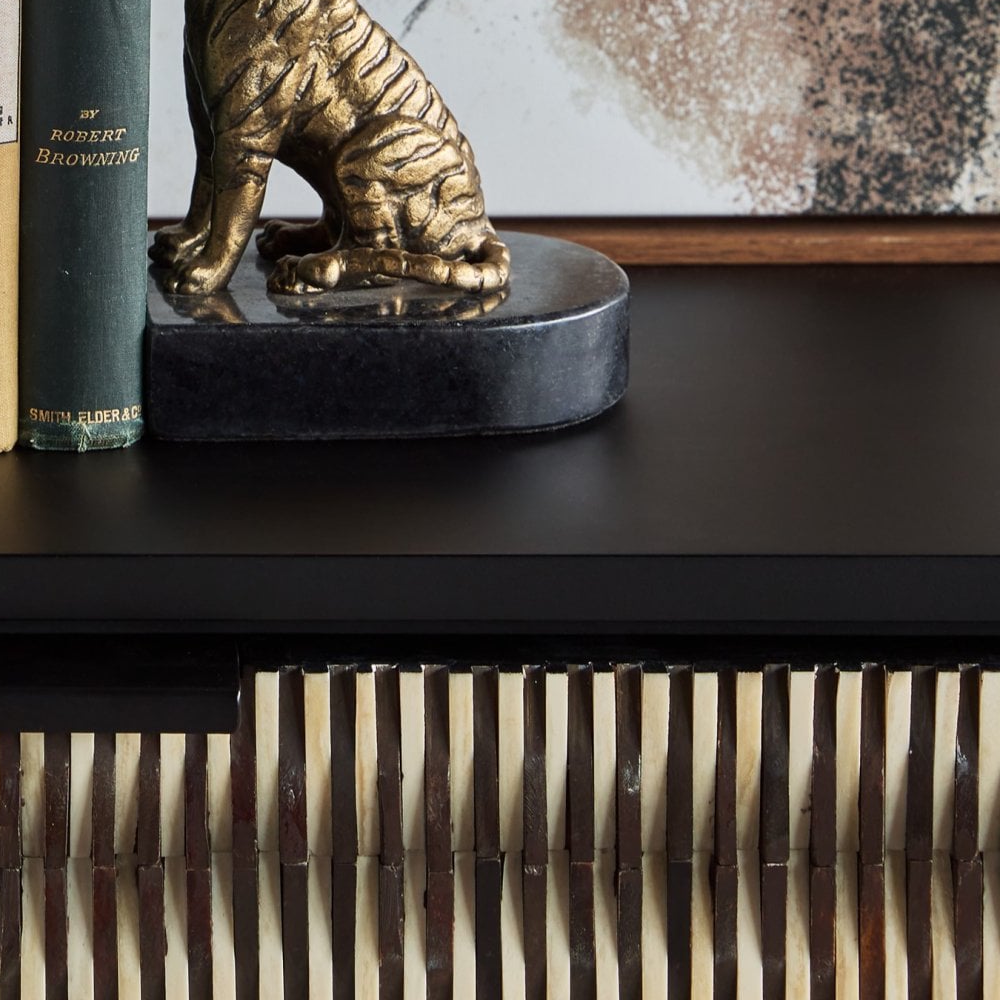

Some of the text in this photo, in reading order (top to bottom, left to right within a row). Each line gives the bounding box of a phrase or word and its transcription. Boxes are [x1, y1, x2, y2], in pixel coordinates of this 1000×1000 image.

[80, 109, 100, 119] BY
[50, 128, 127, 143] ROBERT
[35, 147, 140, 166] BROWNING
[78, 408, 120, 425] ELDER
